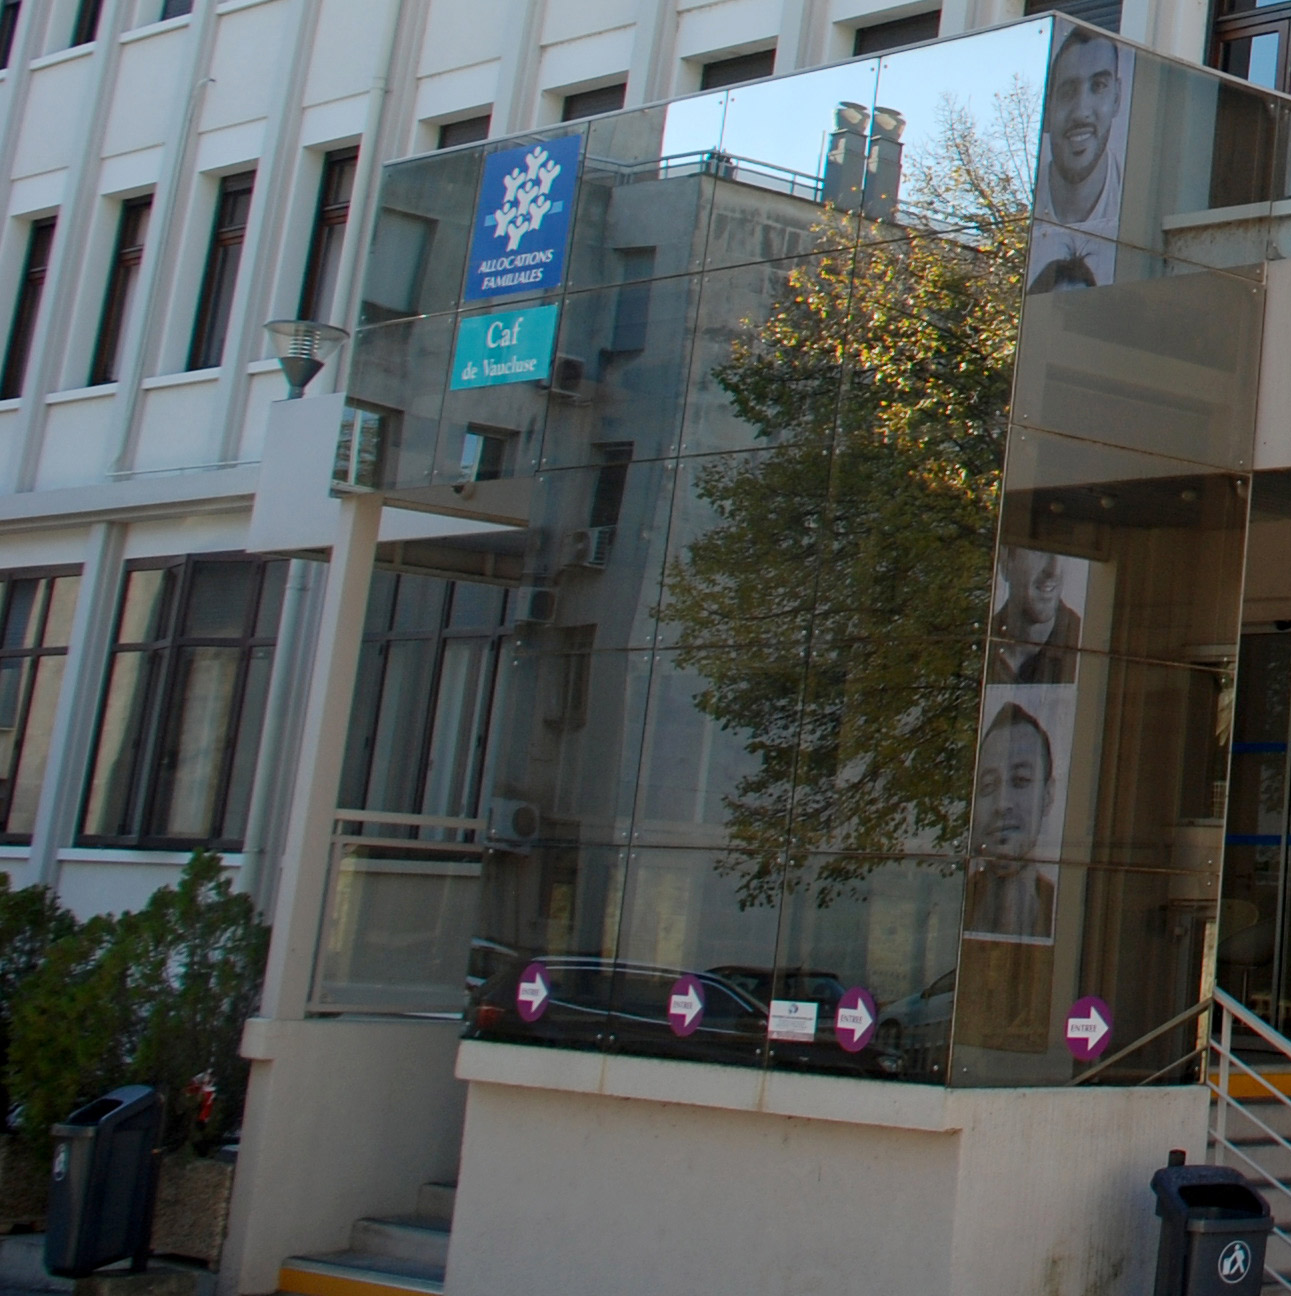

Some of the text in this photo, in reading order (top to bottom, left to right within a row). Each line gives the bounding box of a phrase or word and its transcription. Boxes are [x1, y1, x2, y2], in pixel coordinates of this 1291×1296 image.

[478, 248, 555, 273] ALLOCATIONS
[481, 267, 544, 291] FAMILIALES
[486, 316, 525, 349] Caf
[461, 355, 538, 381] de Vaucluse
